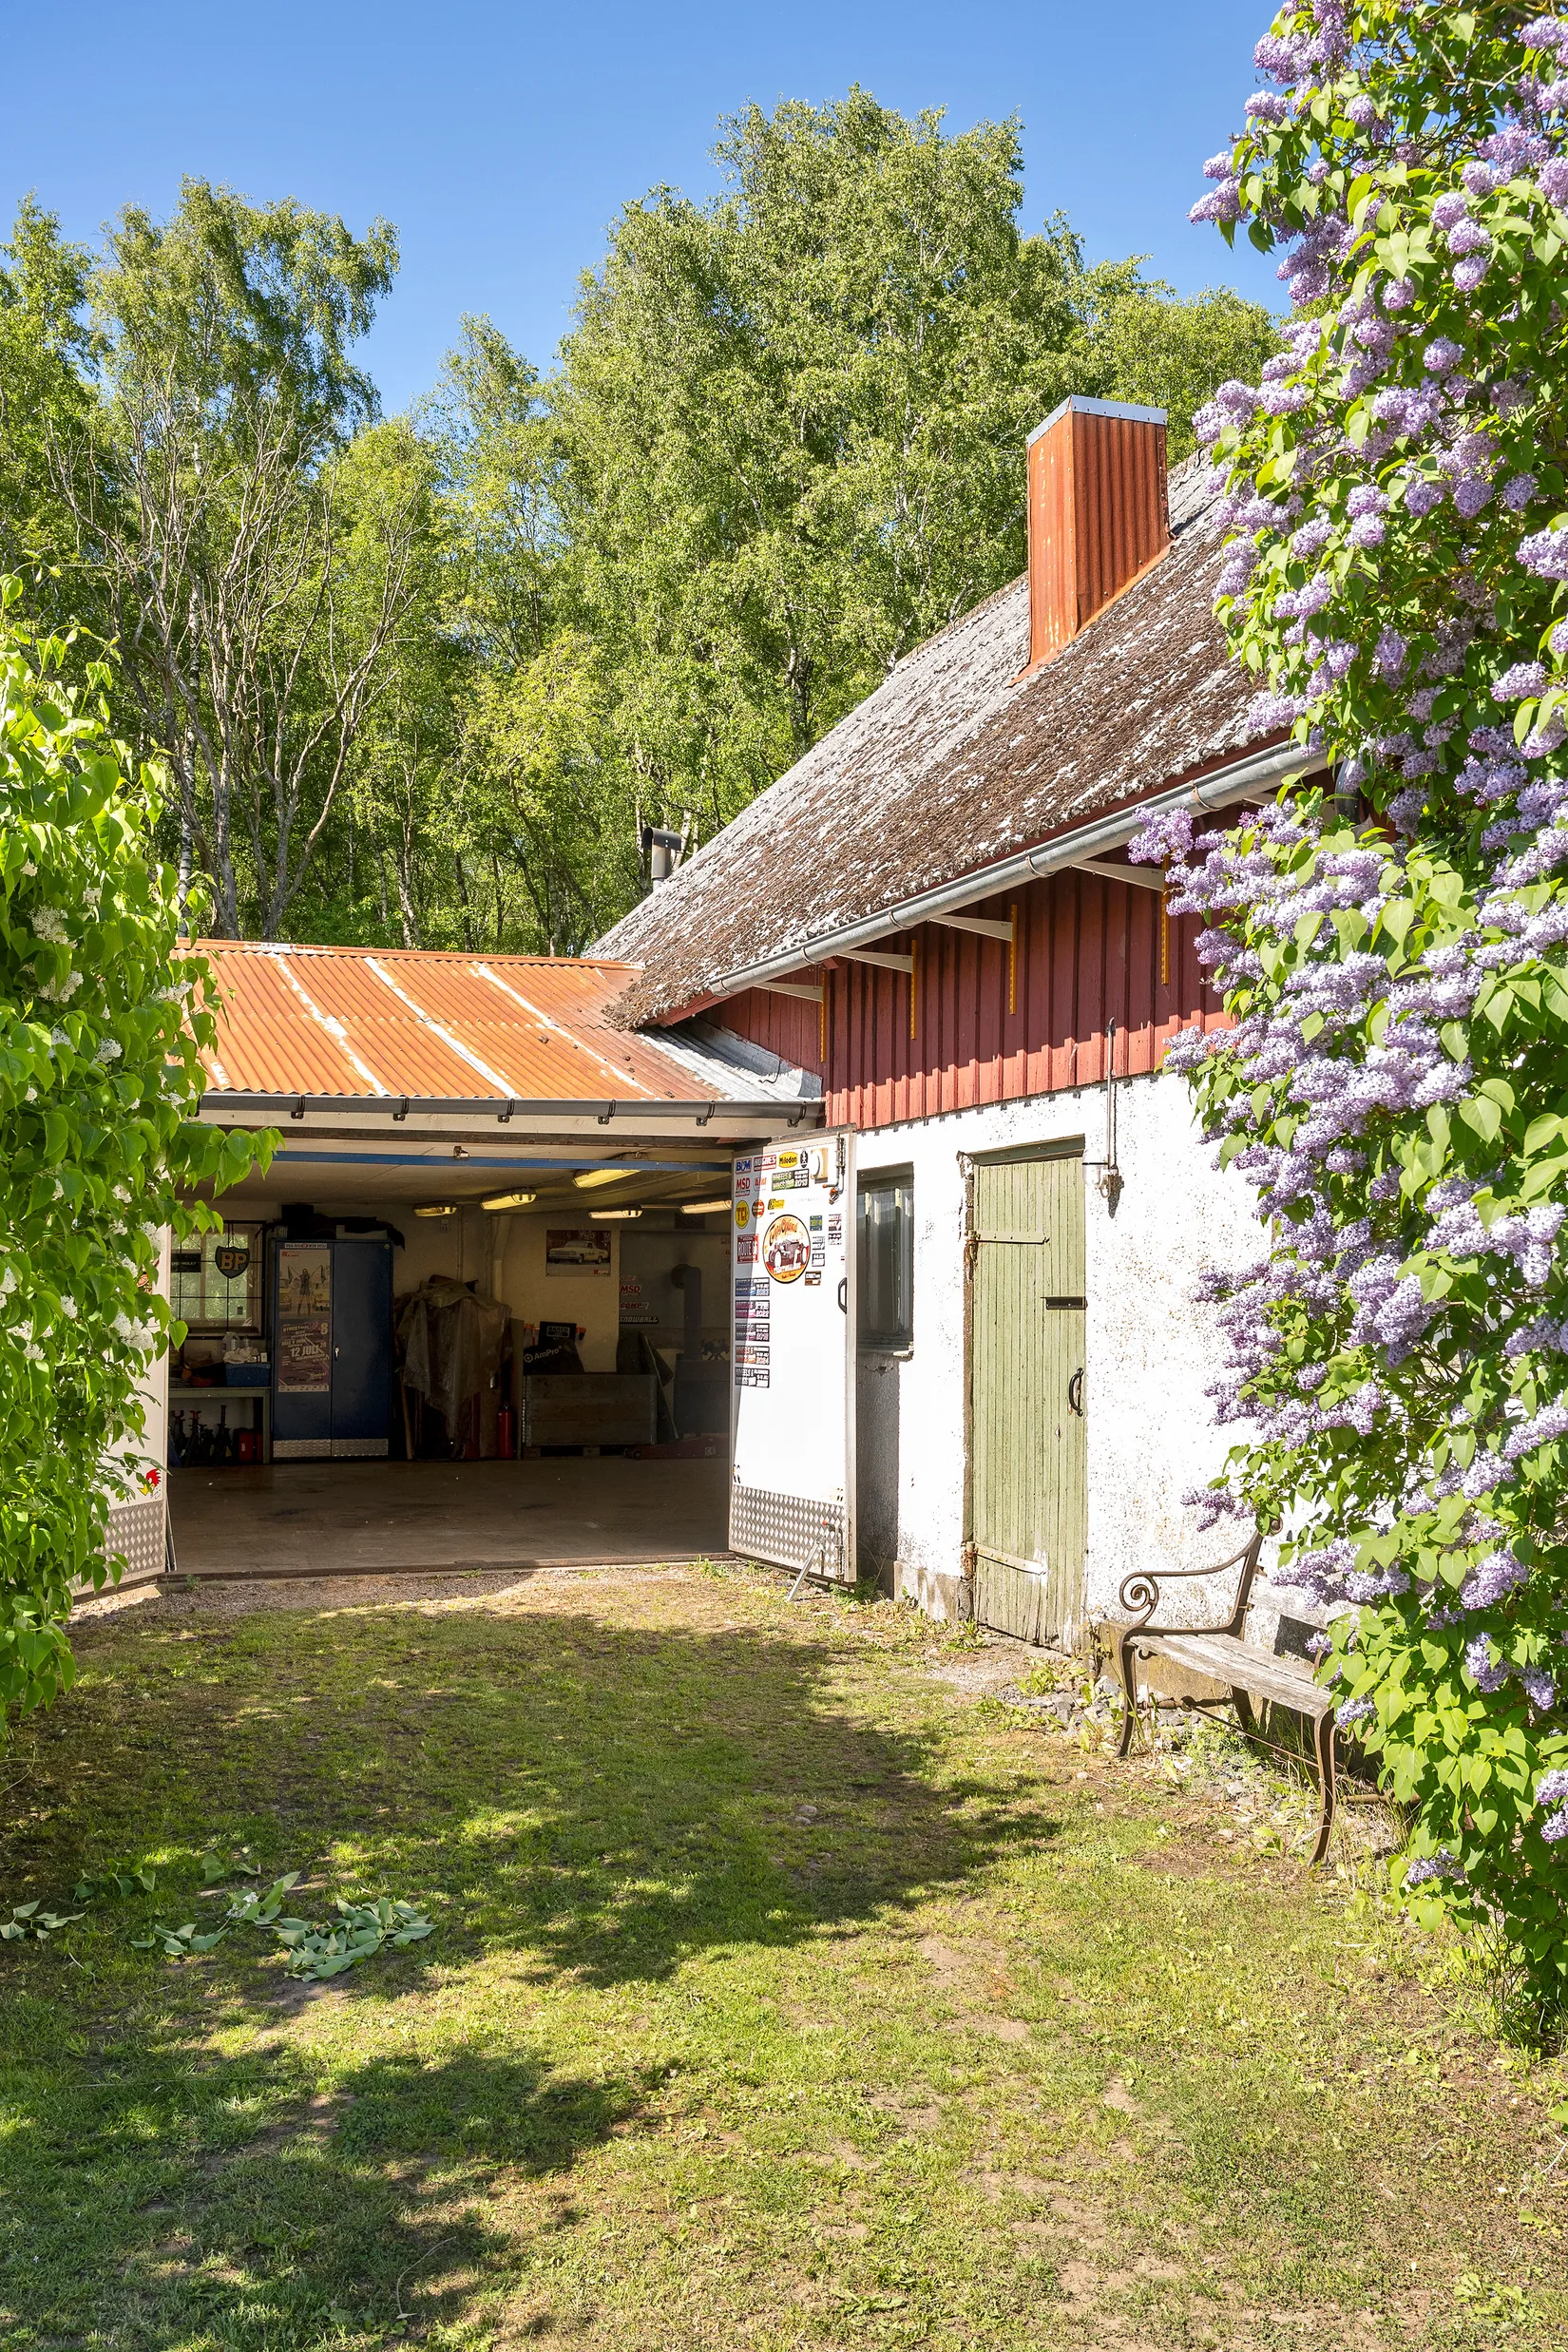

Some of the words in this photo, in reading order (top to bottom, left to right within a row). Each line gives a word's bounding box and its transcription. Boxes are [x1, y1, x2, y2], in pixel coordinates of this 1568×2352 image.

[778, 1156, 797, 1165] Milodon
[736, 1177, 750, 1191] MSD
[737, 1241, 752, 1256] ROUTE
[220, 1251, 247, 1271] BP
[620, 1285, 641, 1293] MSD
[320, 1322, 328, 1335] 8
[290, 1347, 300, 1357] 12
